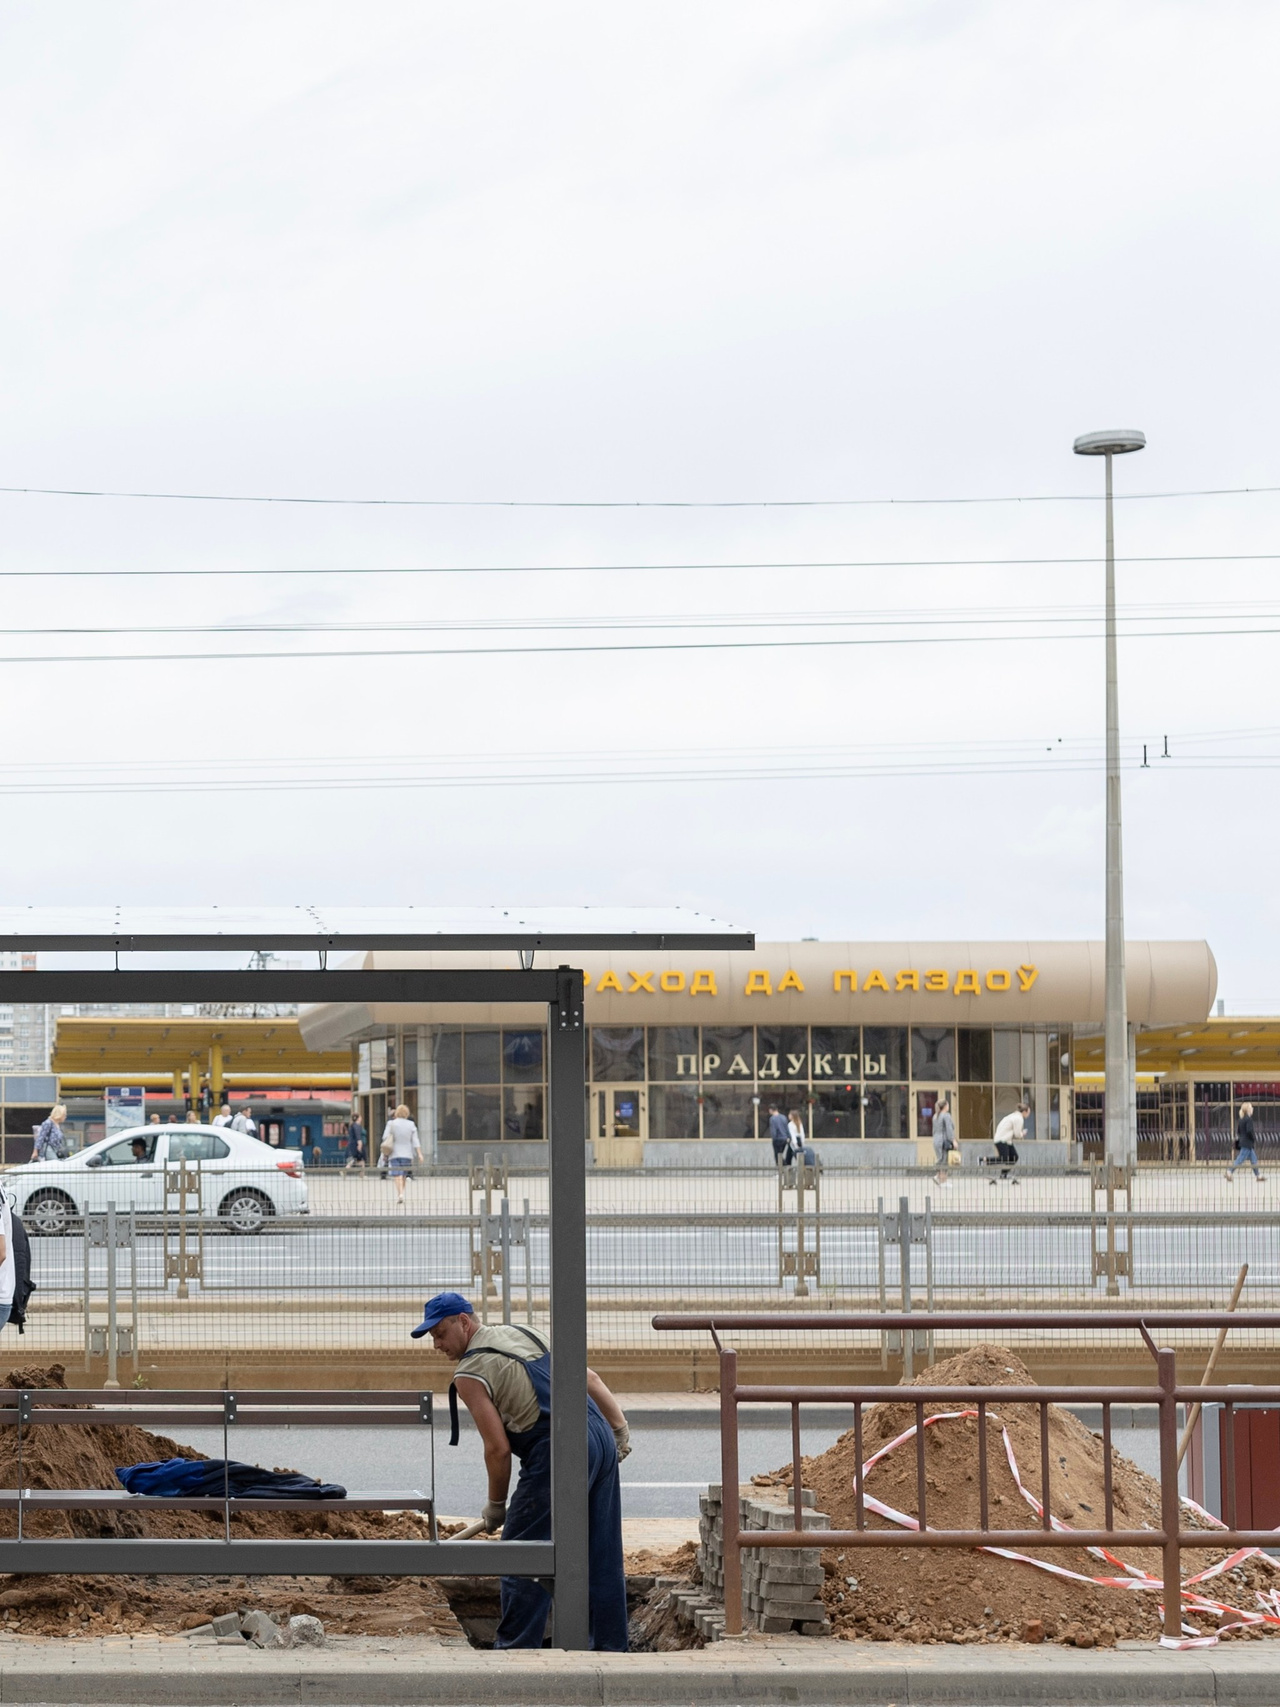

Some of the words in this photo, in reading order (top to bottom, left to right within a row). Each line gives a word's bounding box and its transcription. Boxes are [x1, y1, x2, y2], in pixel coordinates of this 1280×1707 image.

[745, 970, 805, 996] ДА
[833, 964, 1040, 996] ПАЯЗДОЎ
[676, 1053, 887, 1079] ПРАДУКТЫ
